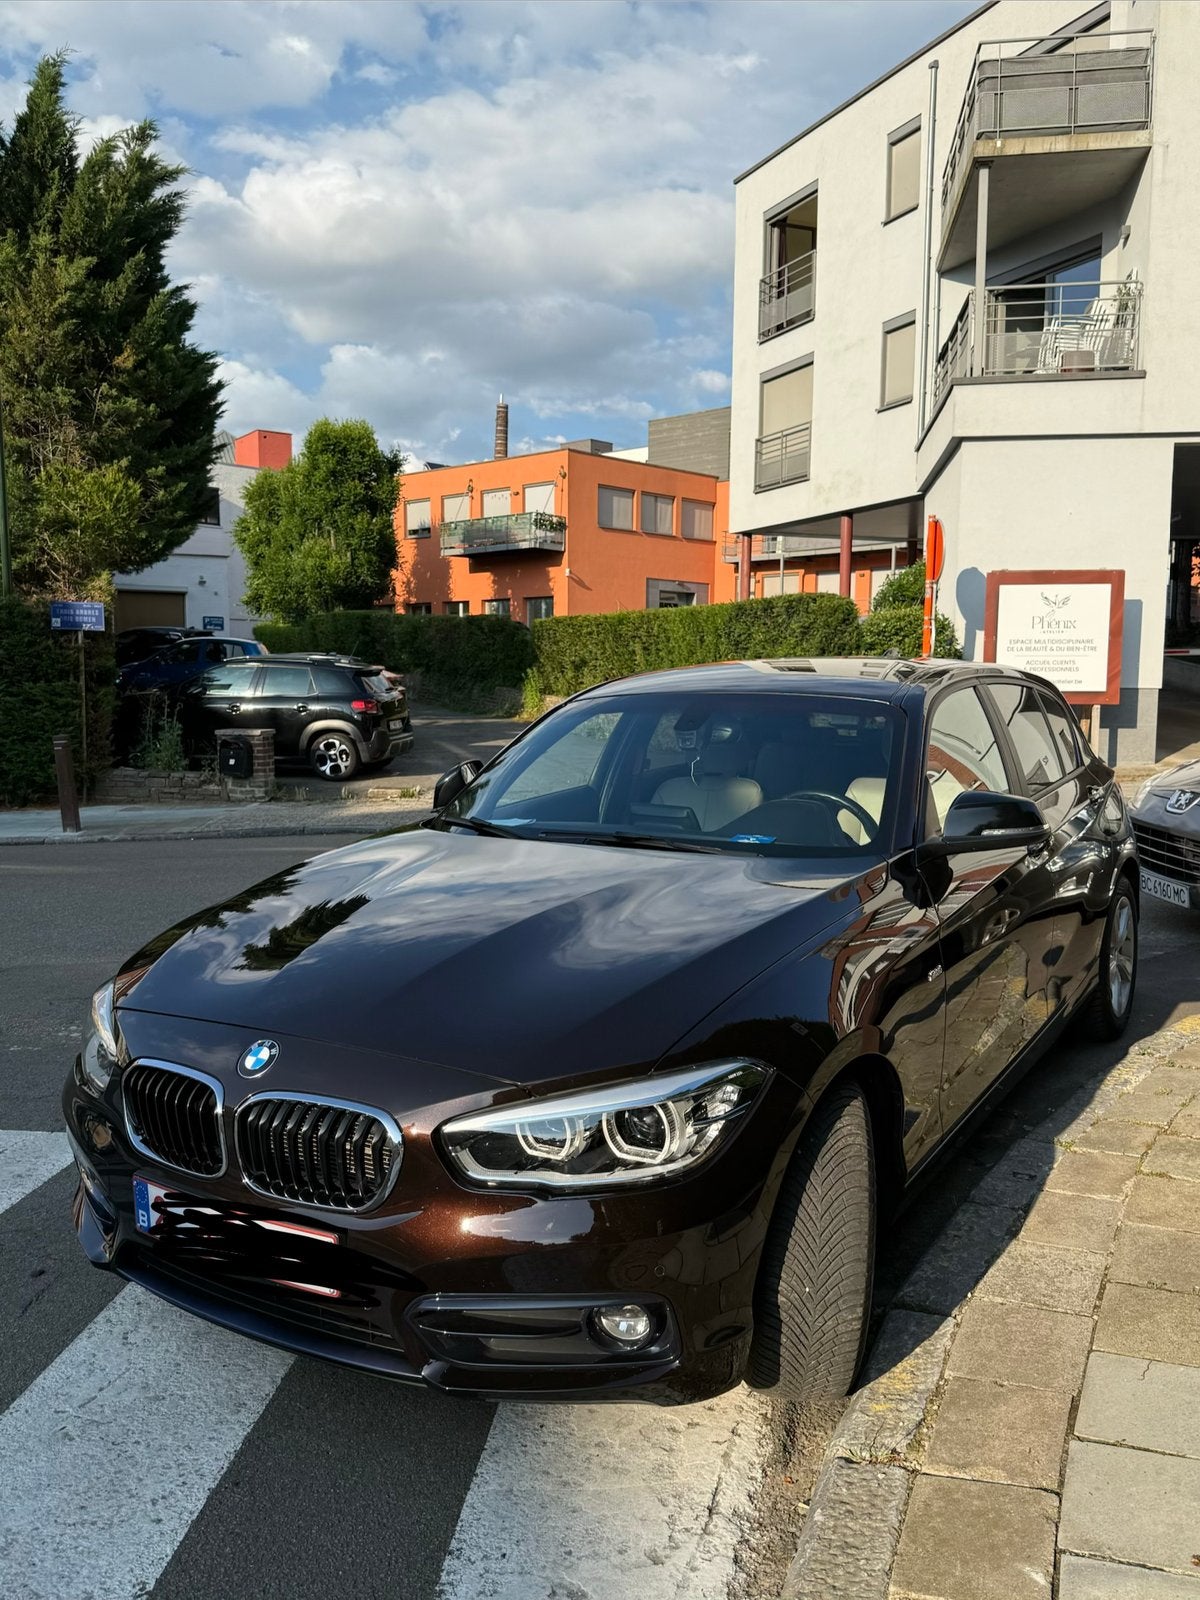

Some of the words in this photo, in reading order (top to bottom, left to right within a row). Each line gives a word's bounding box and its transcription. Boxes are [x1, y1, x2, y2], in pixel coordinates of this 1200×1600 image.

[1141, 874, 1152, 892] BC
[1154, 880, 1172, 899] 6160
[1173, 886, 1186, 904] MC
[251, 1040, 278, 1055] BMW
[140, 1211, 148, 1226] B
